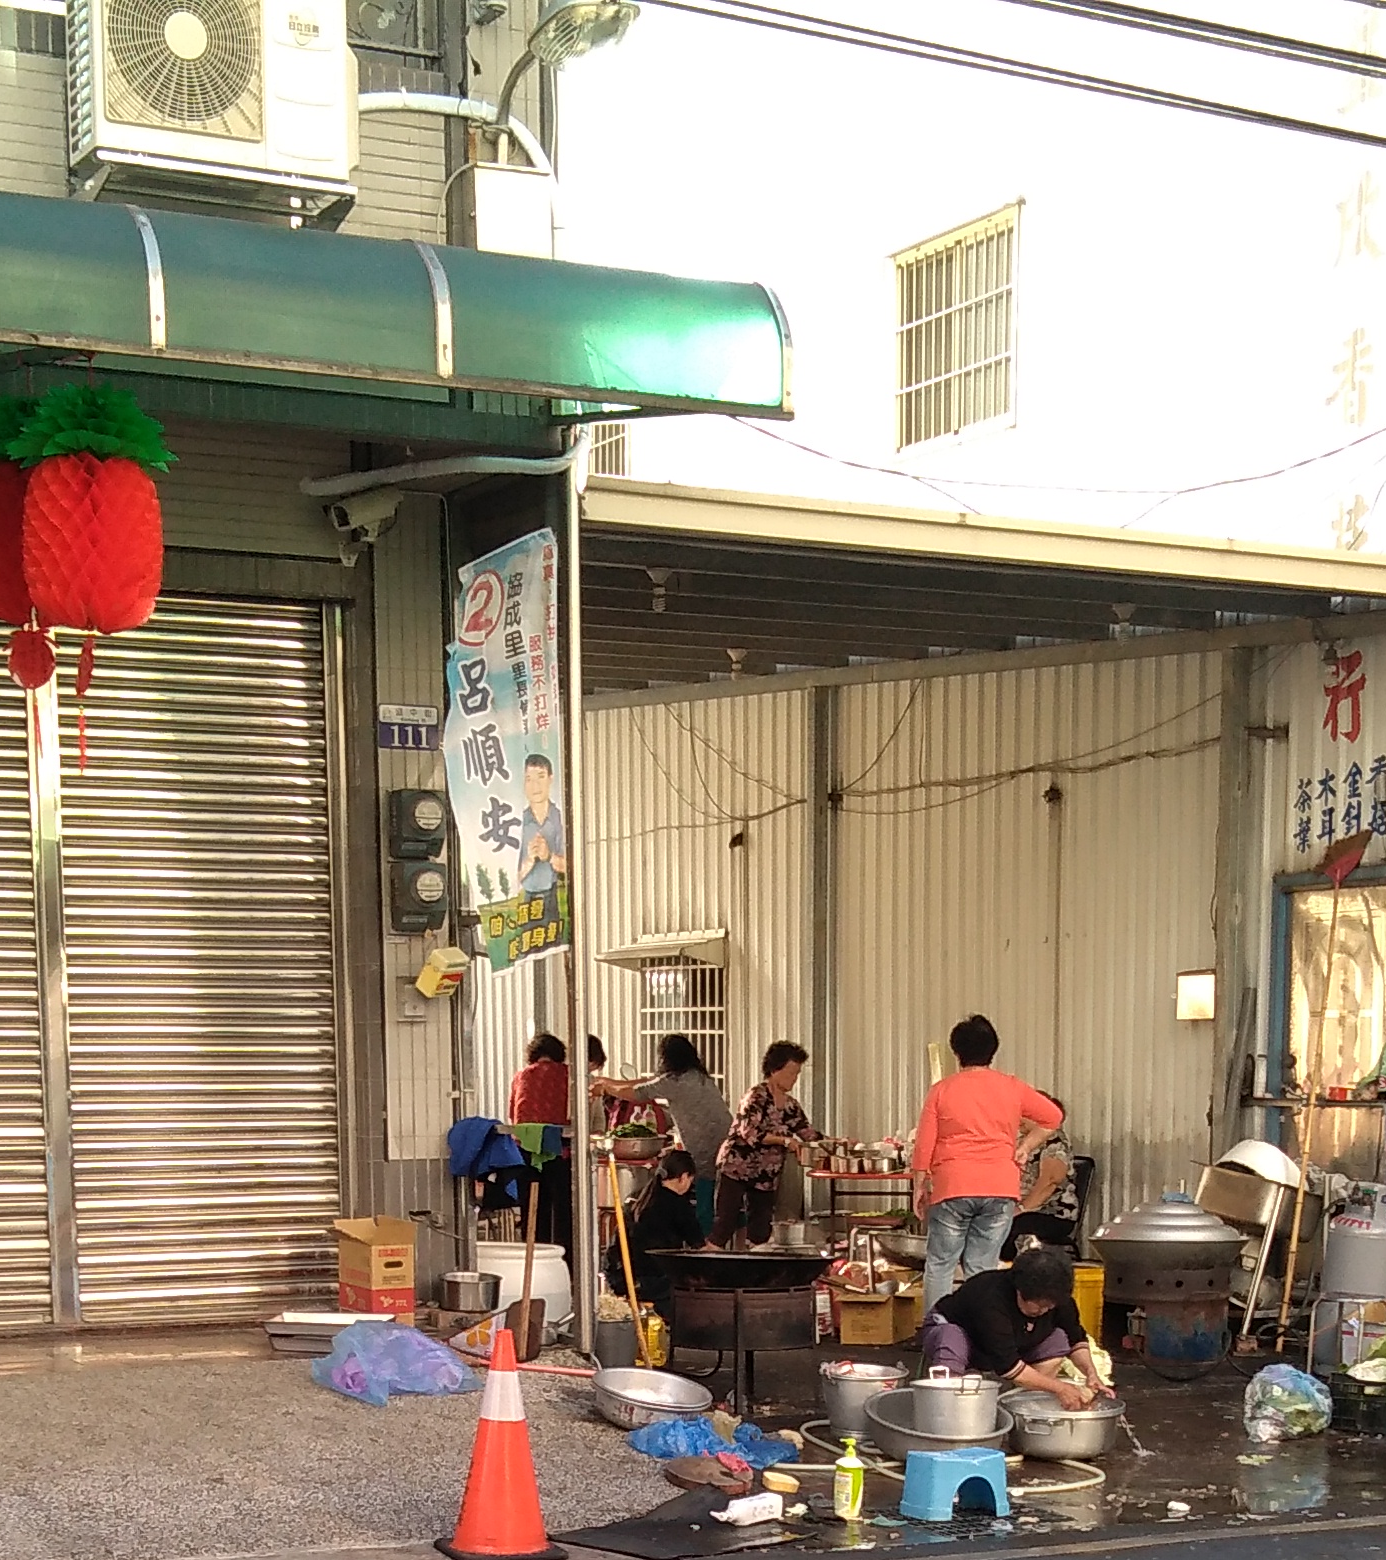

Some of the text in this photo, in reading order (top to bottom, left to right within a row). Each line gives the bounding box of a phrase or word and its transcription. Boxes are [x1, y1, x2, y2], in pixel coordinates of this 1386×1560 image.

[463, 576, 496, 636] 2
[390, 724, 430, 748] 111
[458, 657, 522, 854] 呂順安
[1293, 777, 1313, 854] 茶葉
[1316, 767, 1337, 846] 木耳
[1342, 761, 1363, 836] 金針
